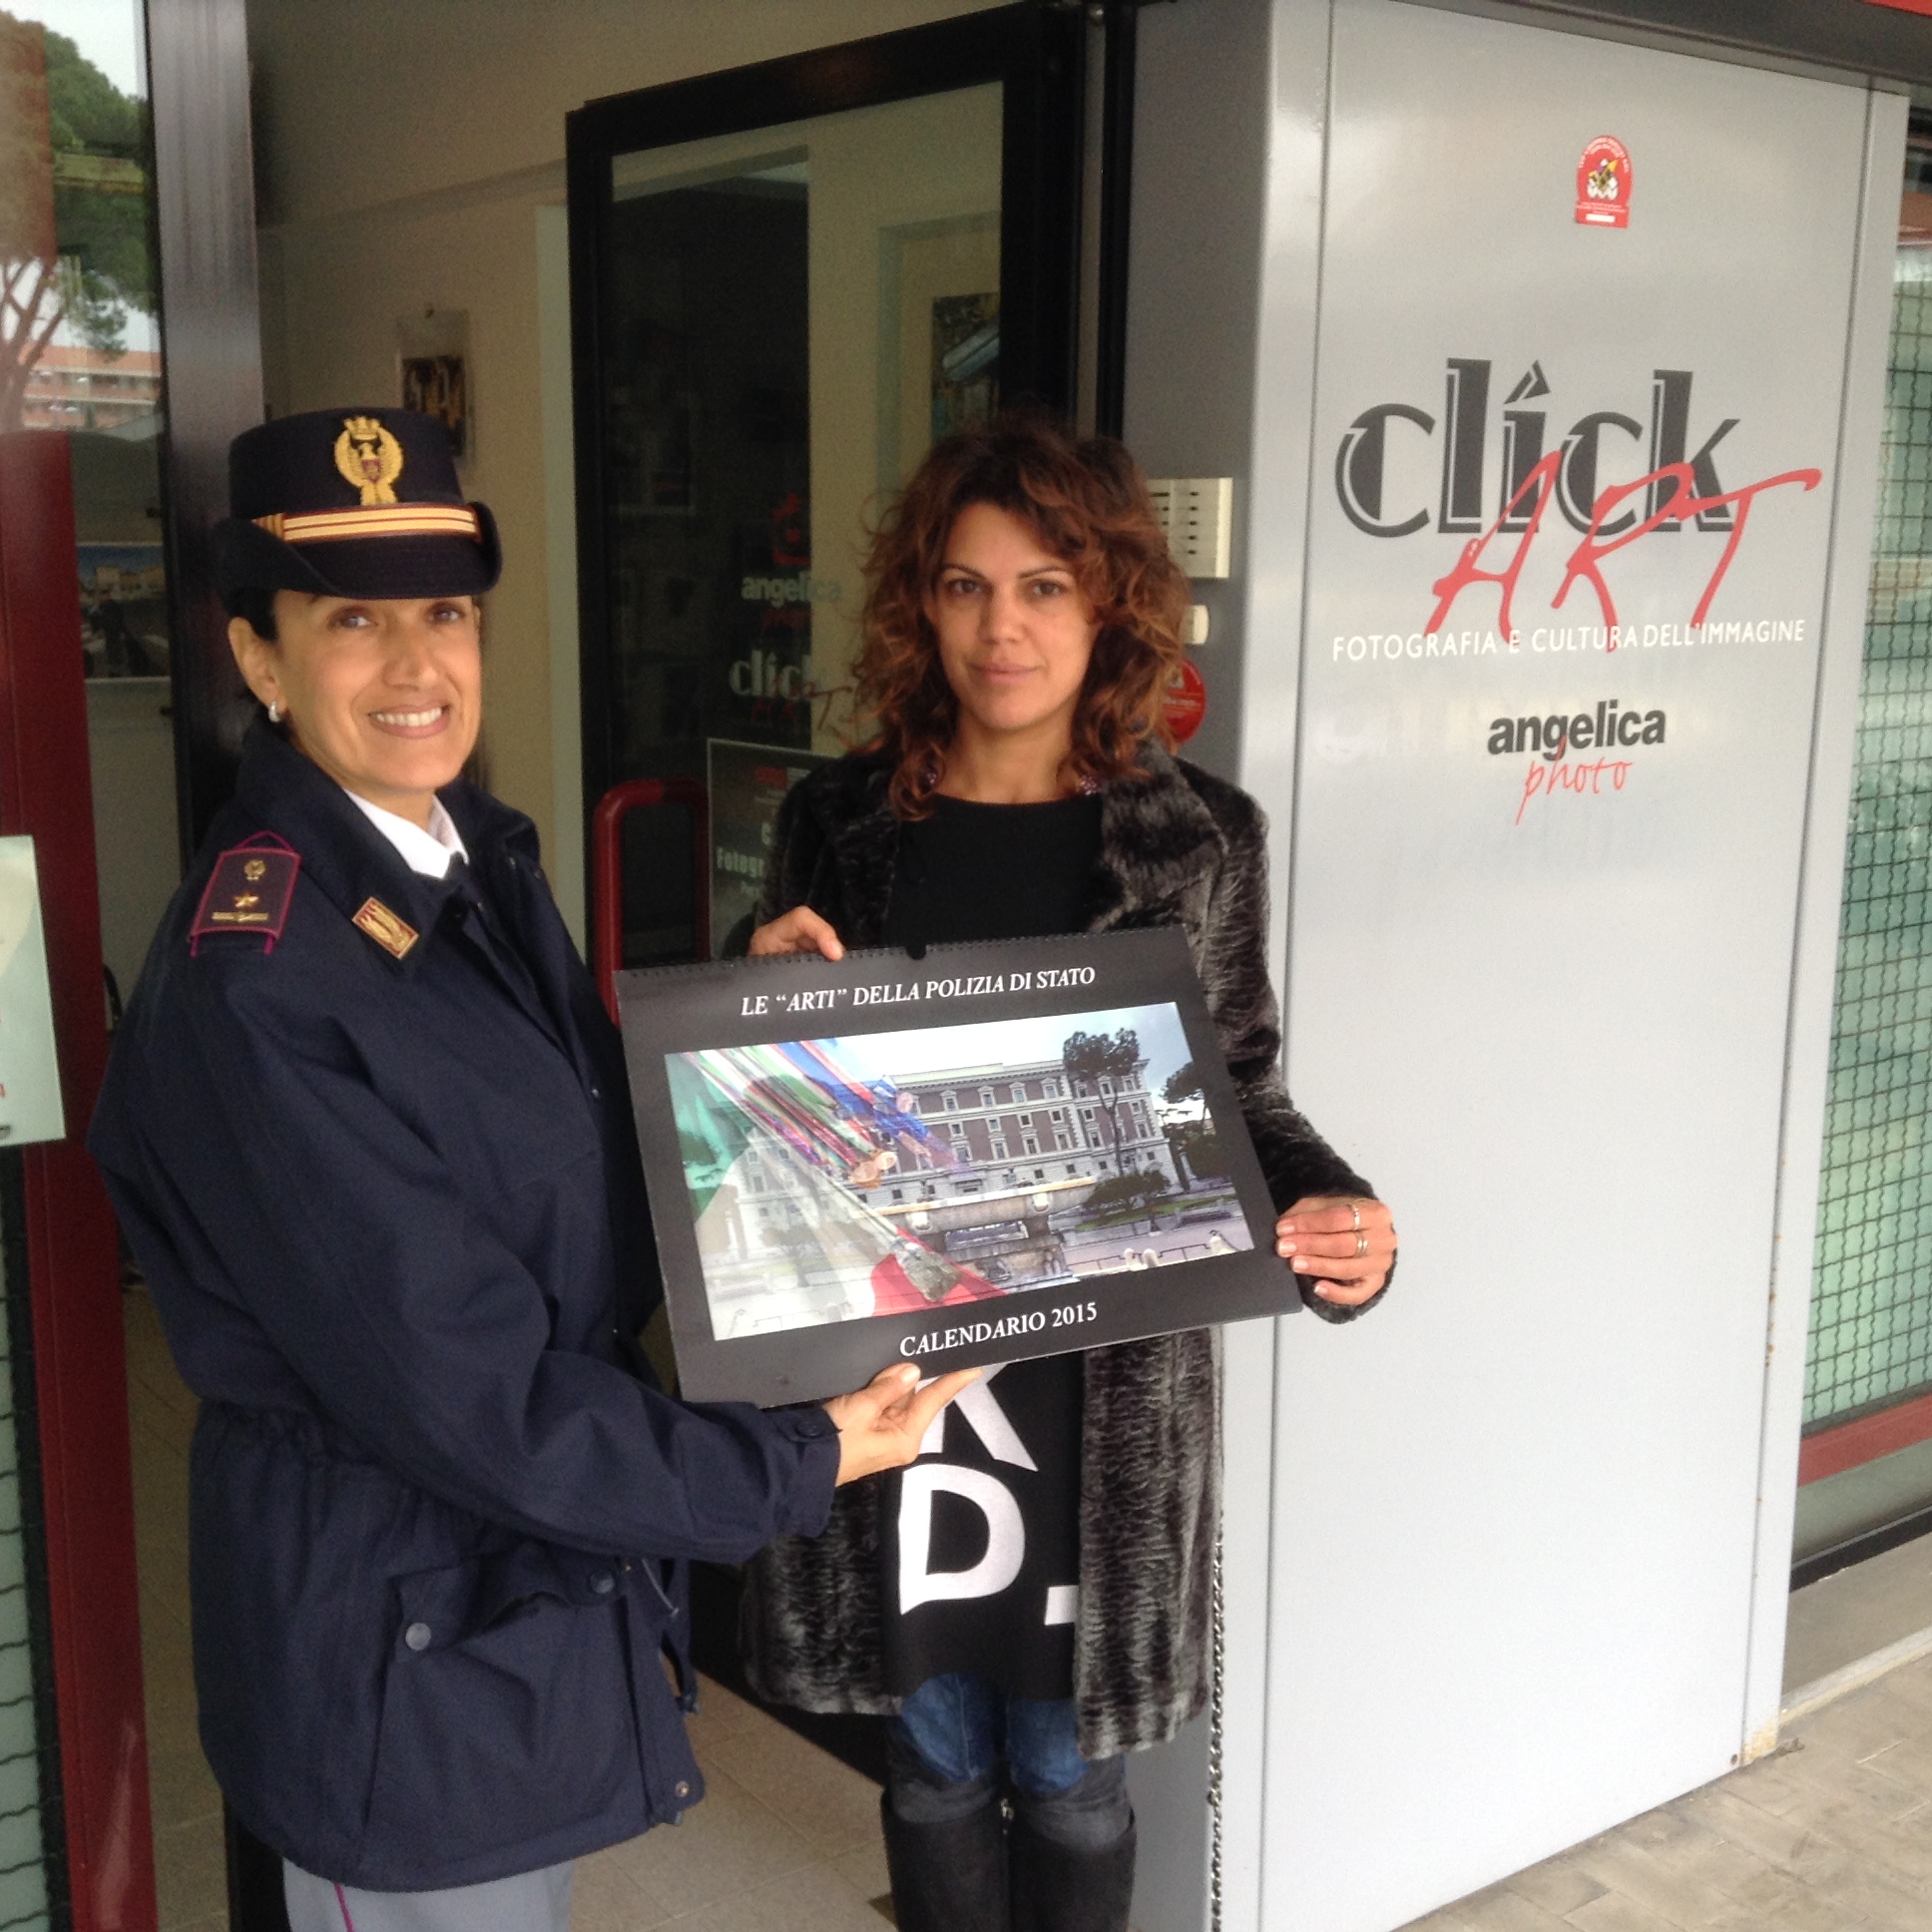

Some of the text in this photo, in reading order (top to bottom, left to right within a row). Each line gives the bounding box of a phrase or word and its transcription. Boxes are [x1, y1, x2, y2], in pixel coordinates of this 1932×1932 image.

[1424, 450, 1822, 653] ART
[1332, 619, 1805, 662] FOTOGRAFIA E CULTURA DELL'IMMAGINE
[1487, 700, 1668, 761] angelica
[1515, 735, 1634, 825] photo
[741, 996, 769, 1016] LE
[853, 983, 920, 1006] DELLA
[925, 975, 1004, 999] POLIZIA
[1009, 972, 1031, 991] DI
[1036, 966, 1096, 989] STATO
[899, 1302, 1098, 1357] CALENDARIO 2015
